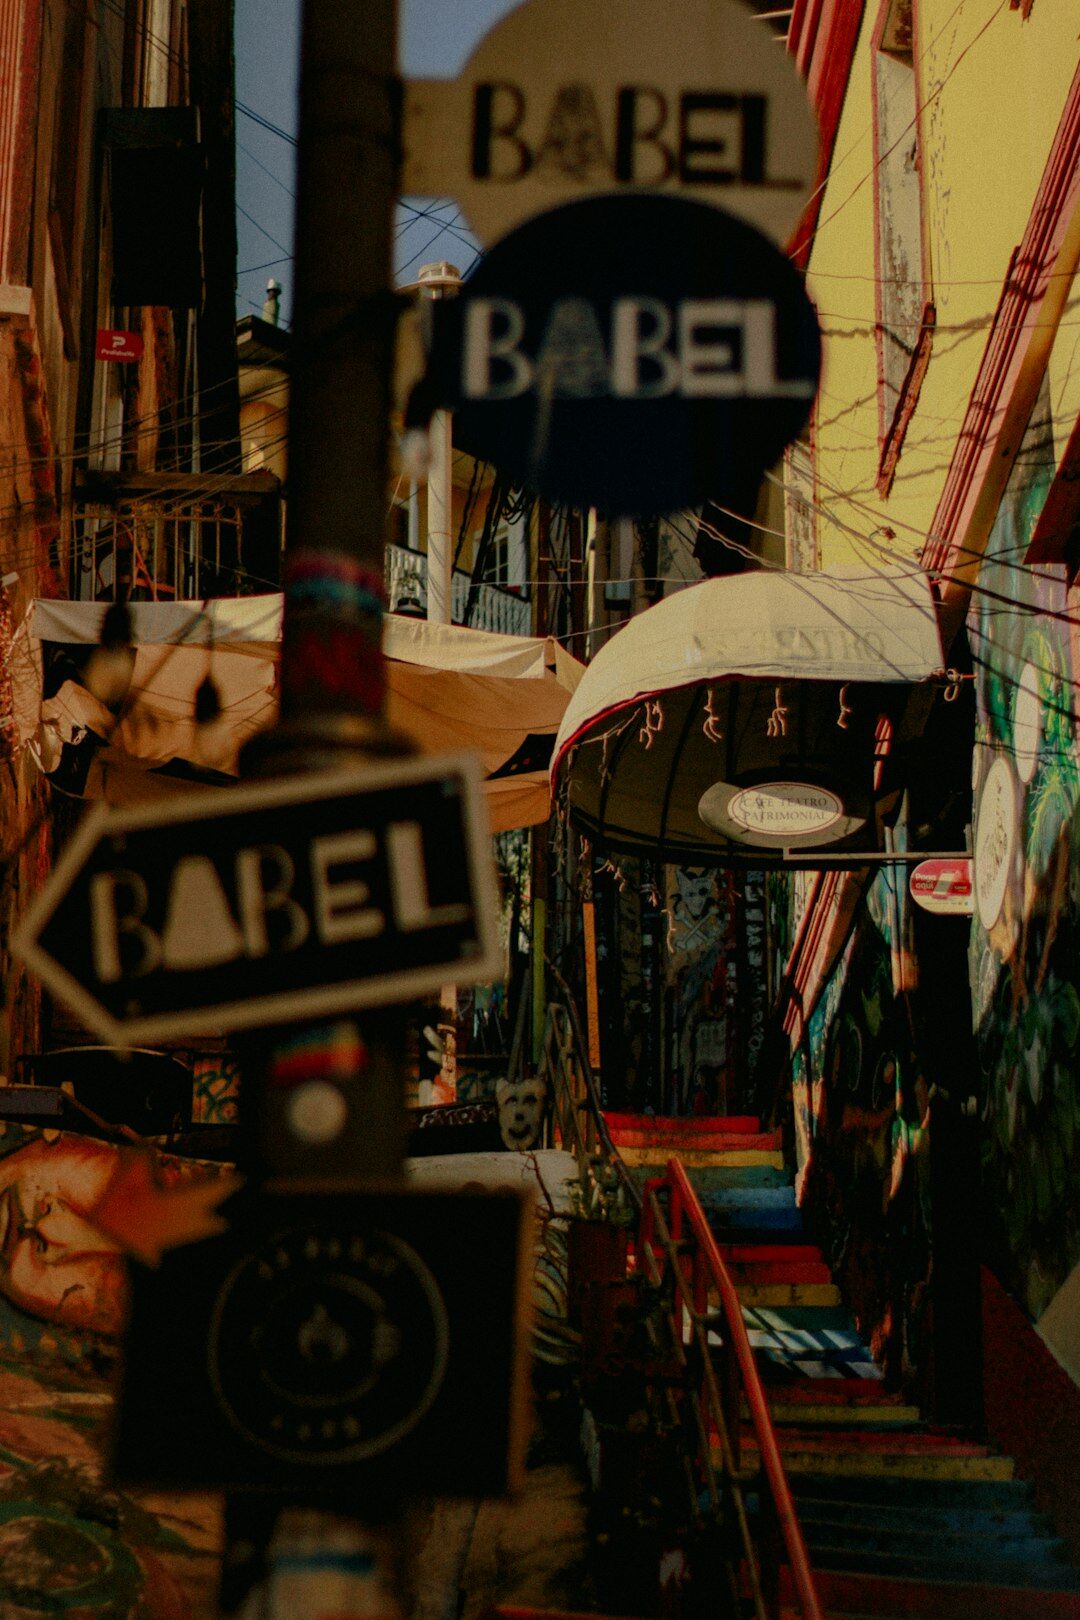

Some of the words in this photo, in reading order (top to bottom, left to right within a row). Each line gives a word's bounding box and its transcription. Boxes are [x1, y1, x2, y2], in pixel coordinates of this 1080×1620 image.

[473, 82, 804, 190] BABEL
[462, 295, 815, 400] BABEL
[780, 797, 828, 808] TEATRO
[88, 818, 472, 985] BABEL
